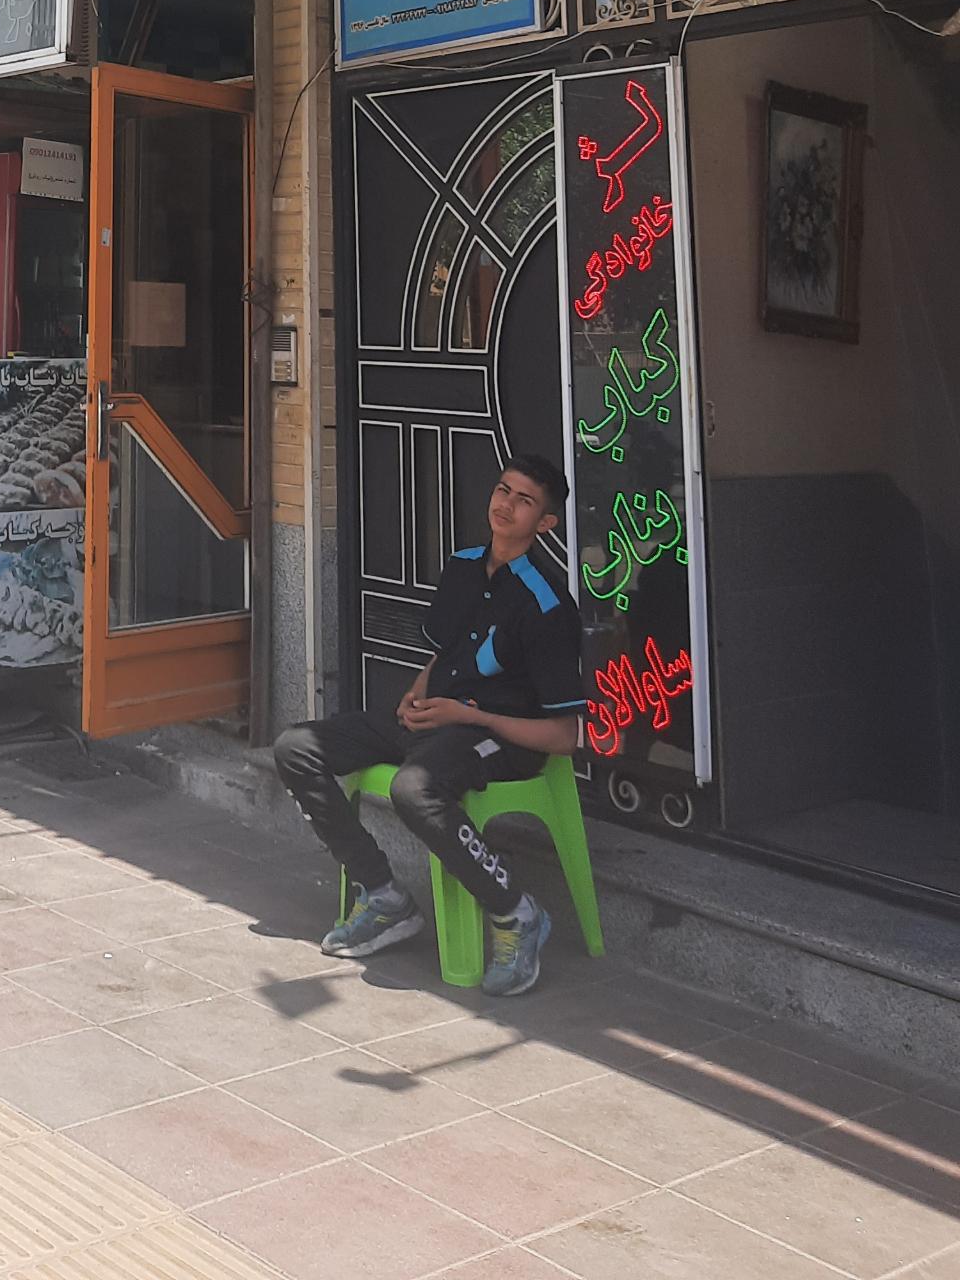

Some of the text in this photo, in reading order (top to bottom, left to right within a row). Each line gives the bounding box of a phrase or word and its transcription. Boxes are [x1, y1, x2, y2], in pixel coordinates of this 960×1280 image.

[0, 367, 12, 392] با
[15, 367, 58, 392] بناب
[61, 367, 87, 392] اب
[575, 80, 695, 756] لژ خانوادگی کباب بناب ساوالان
[44, 520, 85, 543] وجه
